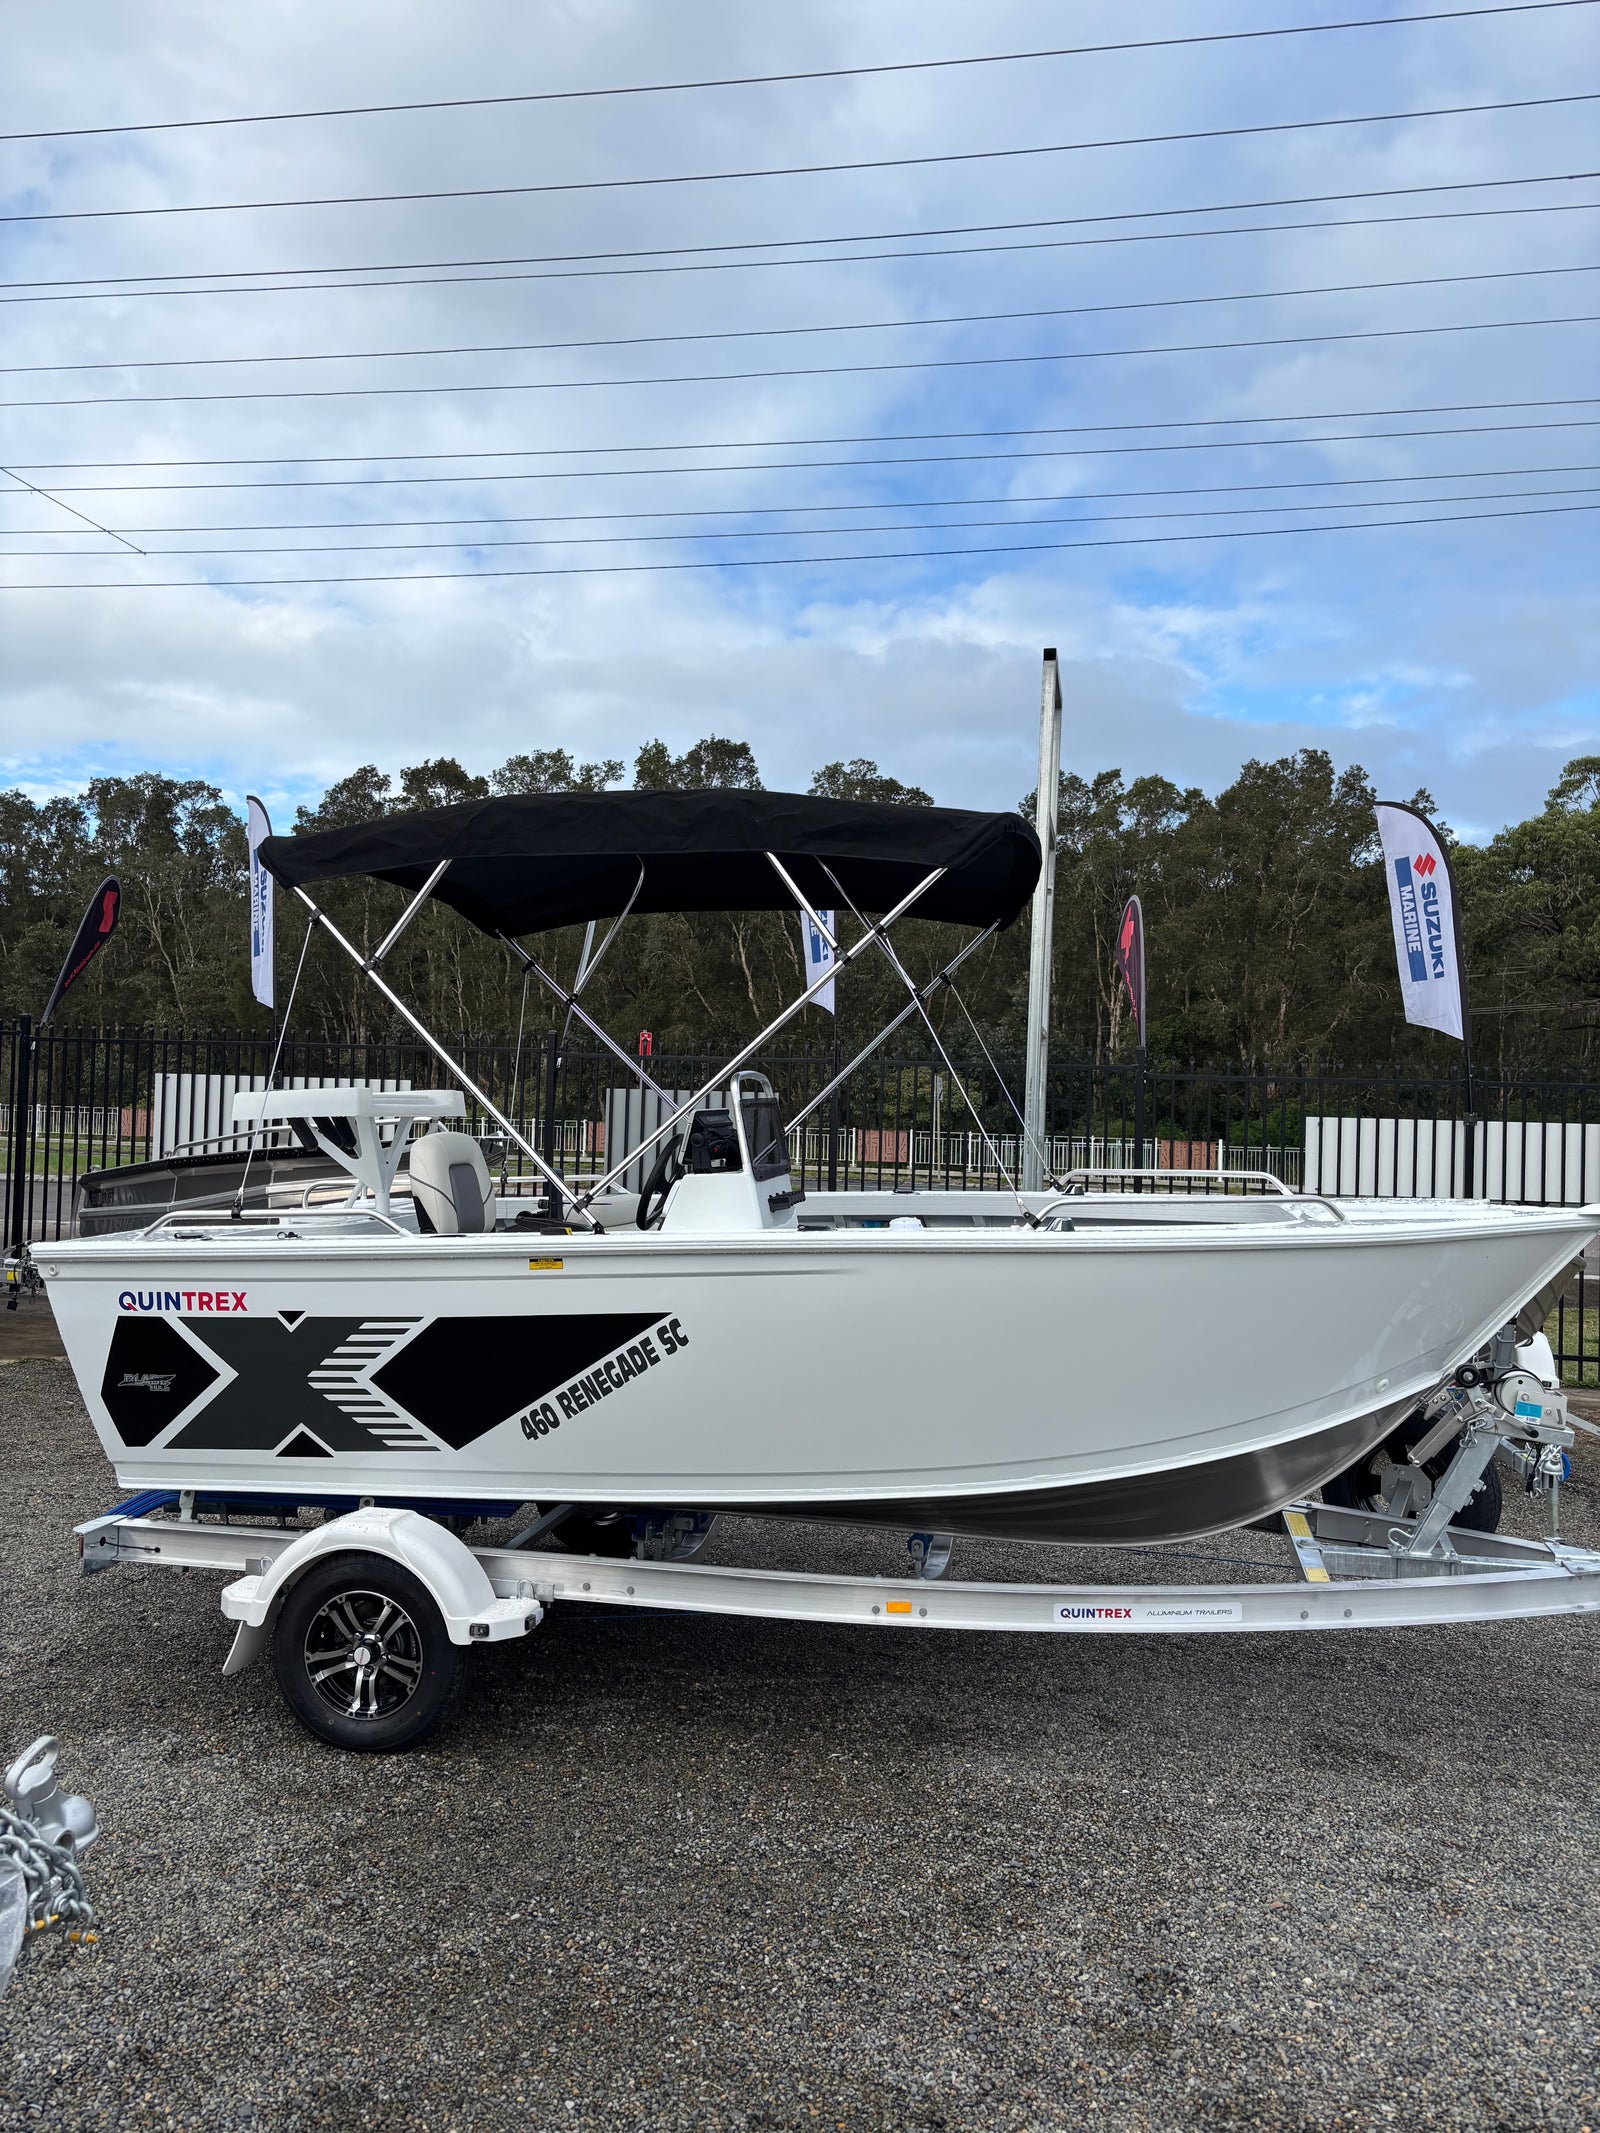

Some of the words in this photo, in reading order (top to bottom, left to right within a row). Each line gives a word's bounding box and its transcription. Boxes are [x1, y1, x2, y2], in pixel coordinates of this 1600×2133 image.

[1400, 885, 1422, 954] MARINE
[1420, 881, 1445, 980] SUZUKI
[118, 1291, 248, 1311] QUINTREX
[519, 1402, 560, 1441] 460
[554, 1335, 662, 1420] RENEGADE
[656, 1317, 690, 1356] SC
[1060, 1608, 1131, 1618] QUINTREX
